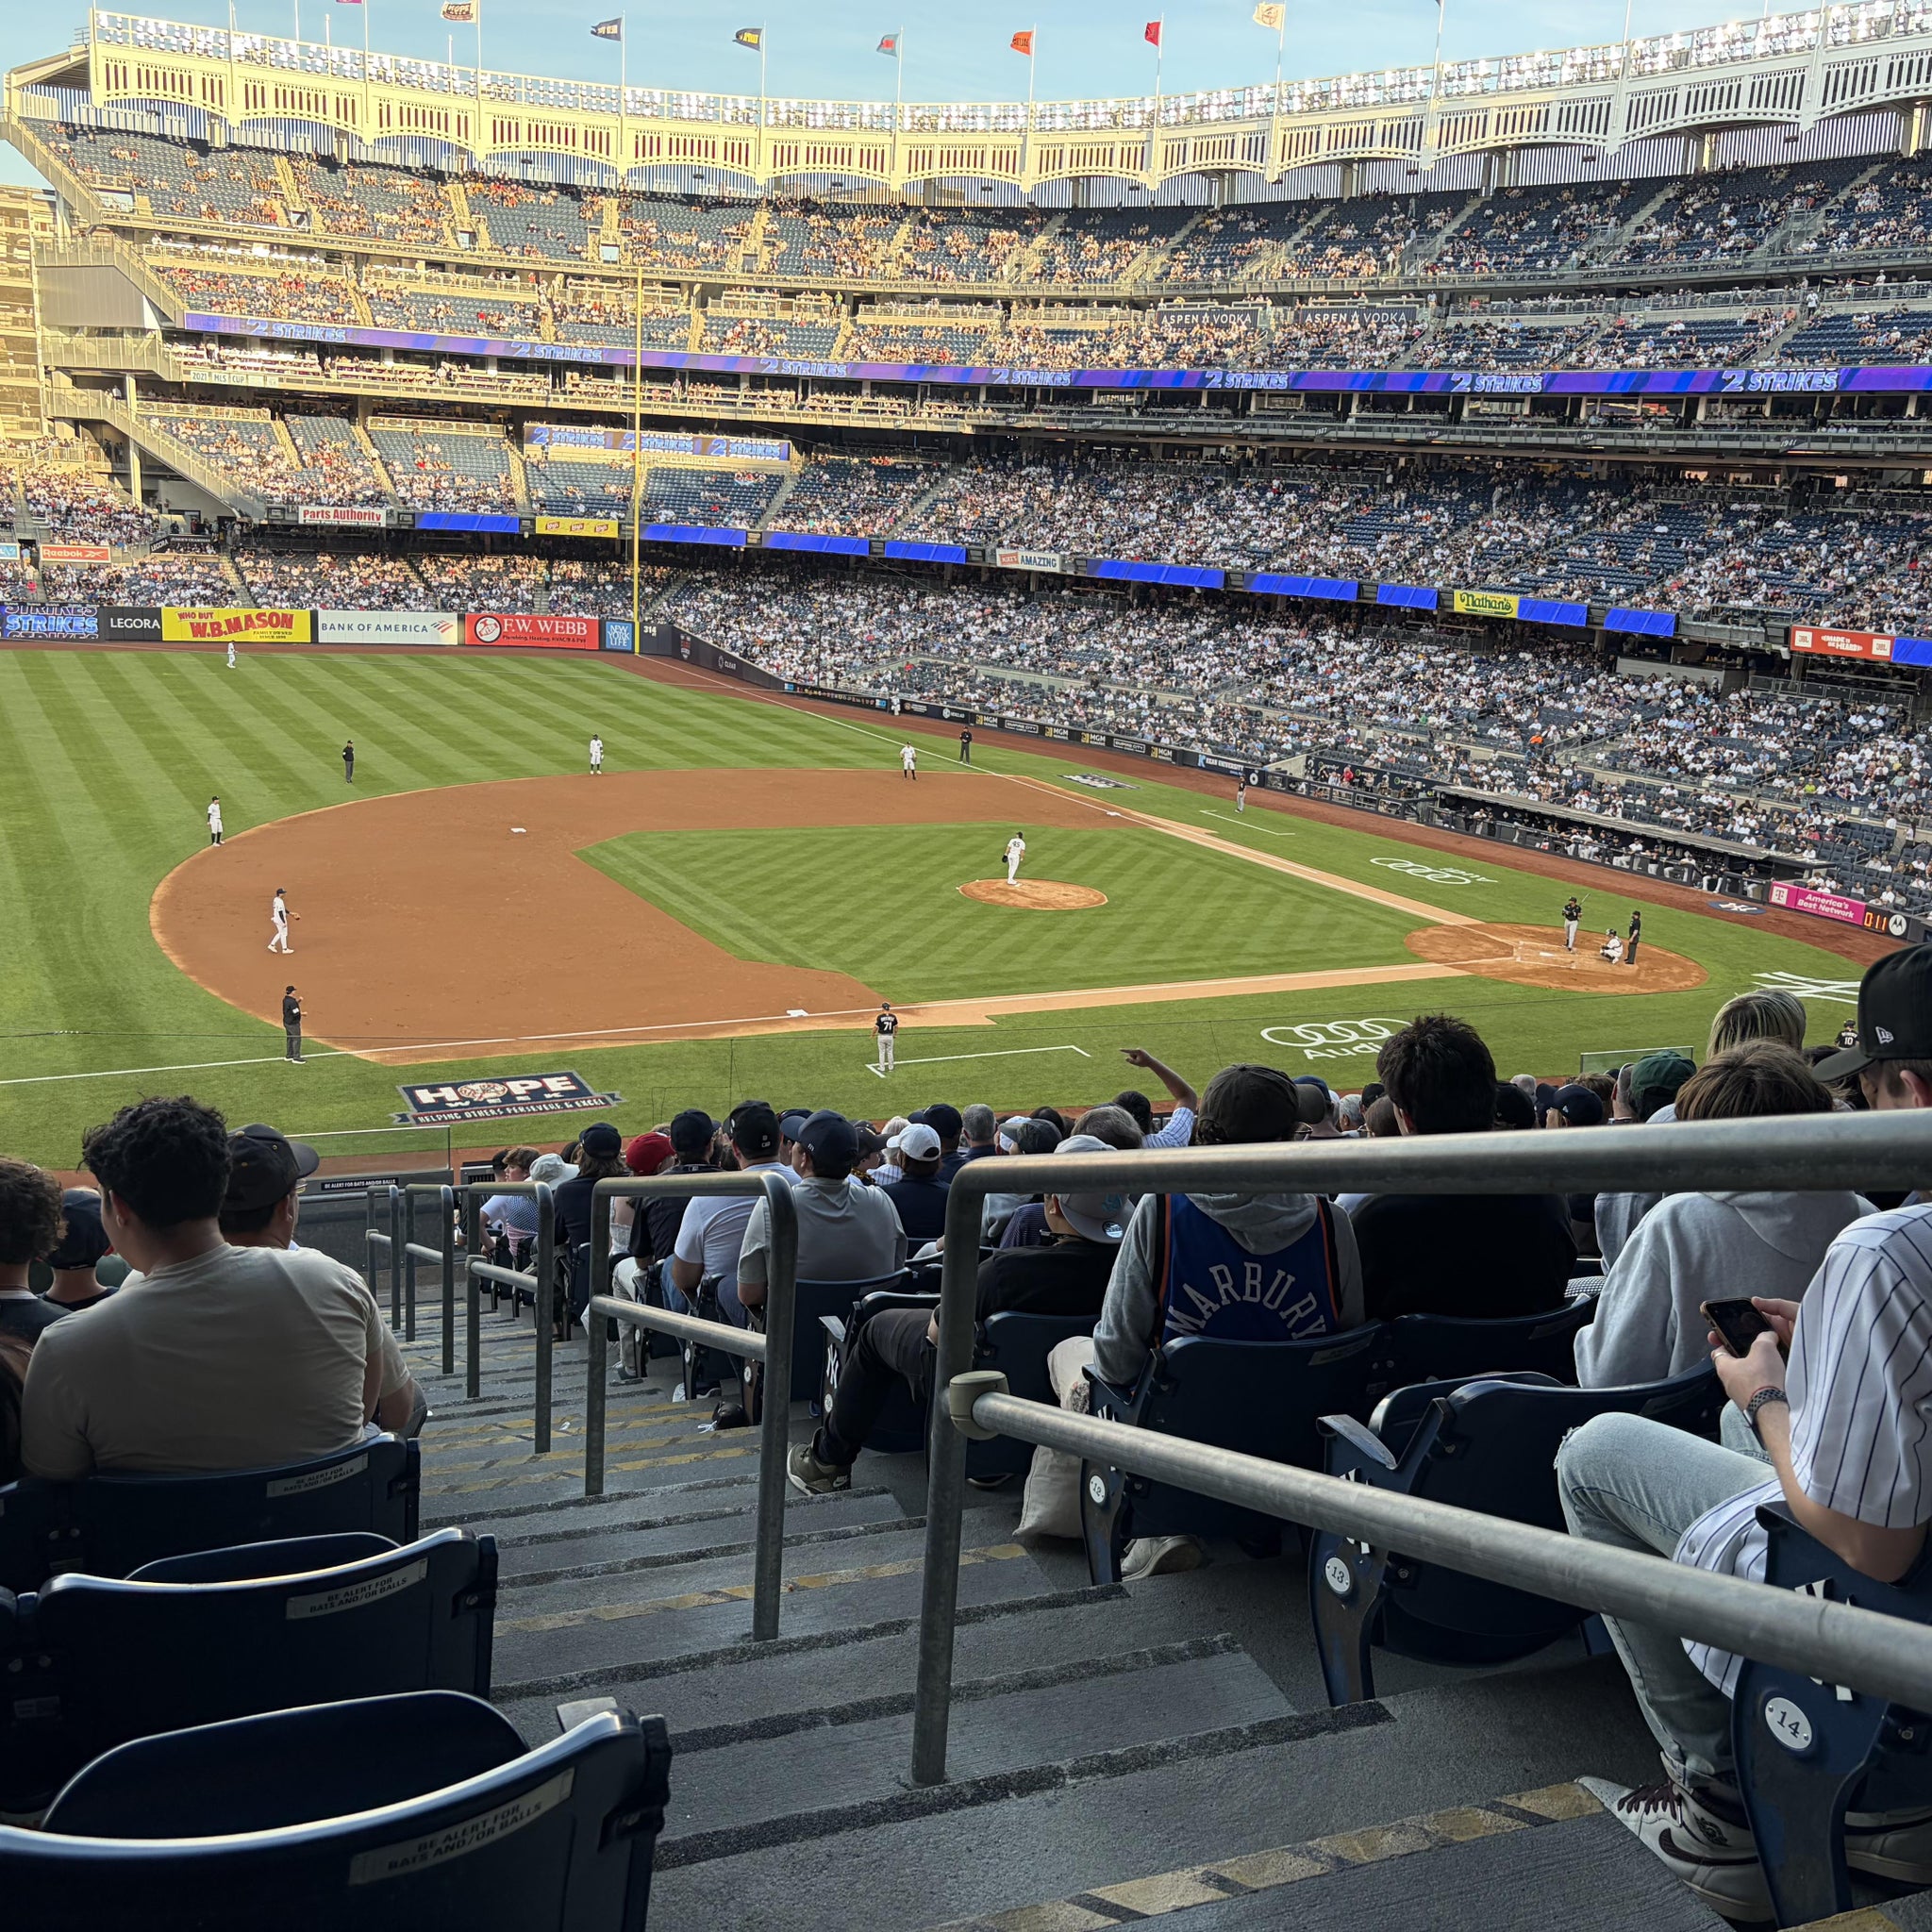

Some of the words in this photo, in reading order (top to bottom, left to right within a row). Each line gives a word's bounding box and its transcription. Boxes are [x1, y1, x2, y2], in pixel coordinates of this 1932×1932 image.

[1161, 314, 1198, 325] ASPEN
[1213, 313, 1251, 325] VODKA
[1306, 313, 1347, 324] ASPEN
[1363, 311, 1407, 323] VODKA
[247, 319, 268, 336] 2
[272, 322, 345, 341] STRIKES
[511, 341, 530, 358] 2
[534, 345, 602, 362] STRIKES
[760, 358, 778, 374] 2
[781, 361, 847, 377] STRIKES
[992, 369, 1009, 384] 2
[1011, 371, 1071, 386] STRIKES
[1206, 372, 1222, 388] 2
[1224, 374, 1288, 389] STRIKES
[1450, 374, 1473, 392] 2
[1474, 375, 1543, 392] STRIKES
[1722, 370, 1745, 392] 2
[1748, 371, 1839, 391] STRIKES
[533, 426, 549, 444] 2
[552, 431, 605, 445] STRIKES
[641, 439, 693, 451] STRIKES
[710, 438, 726, 456] 2
[729, 441, 780, 457] STRIKES
[303, 509, 330, 519] Parts
[333, 508, 381, 522] Authority
[42, 549, 83, 558] Reebok
[1021, 555, 1057, 568] AMAZING
[1460, 592, 1512, 610] Nathan's
[6, 615, 98, 633] STRIKES
[110, 618, 160, 629] LEGORA
[321, 623, 354, 631] BANK
[375, 625, 428, 633] AMERICA
[503, 618, 532, 633] F.W.
[537, 620, 588, 636] WEBB
[609, 625, 628, 633] NEW
[643, 625, 657, 634] 314
[608, 631, 630, 641] YORK
[609, 639, 628, 647] LIFE
[983, 715, 998, 724] MGM
[1054, 727, 1069, 736] MGM
[1091, 734, 1106, 742] MGM
[1158, 747, 1172, 758] MGM
[1798, 898, 1816, 910] Best
[1820, 905, 1855, 918] Network
[1806, 893, 1849, 909] America's
[883, 1022, 892, 1031] 71
[1844, 1037, 1854, 1045] 10
[1304, 1042, 1382, 1059] Audi
[418, 1112, 461, 1124] HELPING
[465, 1108, 504, 1119] OTHERS
[507, 1102, 562, 1115] PERSEVERE
[575, 1098, 606, 1108] EXCEL
[1165, 1261, 1327, 1340] MARBURY
[308, 1472, 328, 1482] ALERT
[334, 1468, 354, 1480] BALLS
[1093, 1483, 1102, 1496] 12
[1331, 1567, 1345, 1584] 13
[309, 1602, 335, 1613] BATS
[379, 1577, 408, 1594] BALLS
[343, 1584, 373, 1598] ALERT
[375, 1577, 392, 1589] FOR
[1776, 1710, 1803, 1739] 14
[388, 1853, 428, 1871] BATS
[499, 1802, 542, 1829] BALLS
[418, 1840, 438, 1852] BE
[443, 1820, 488, 1842] ALERT
[493, 1805, 520, 1823] FOR
